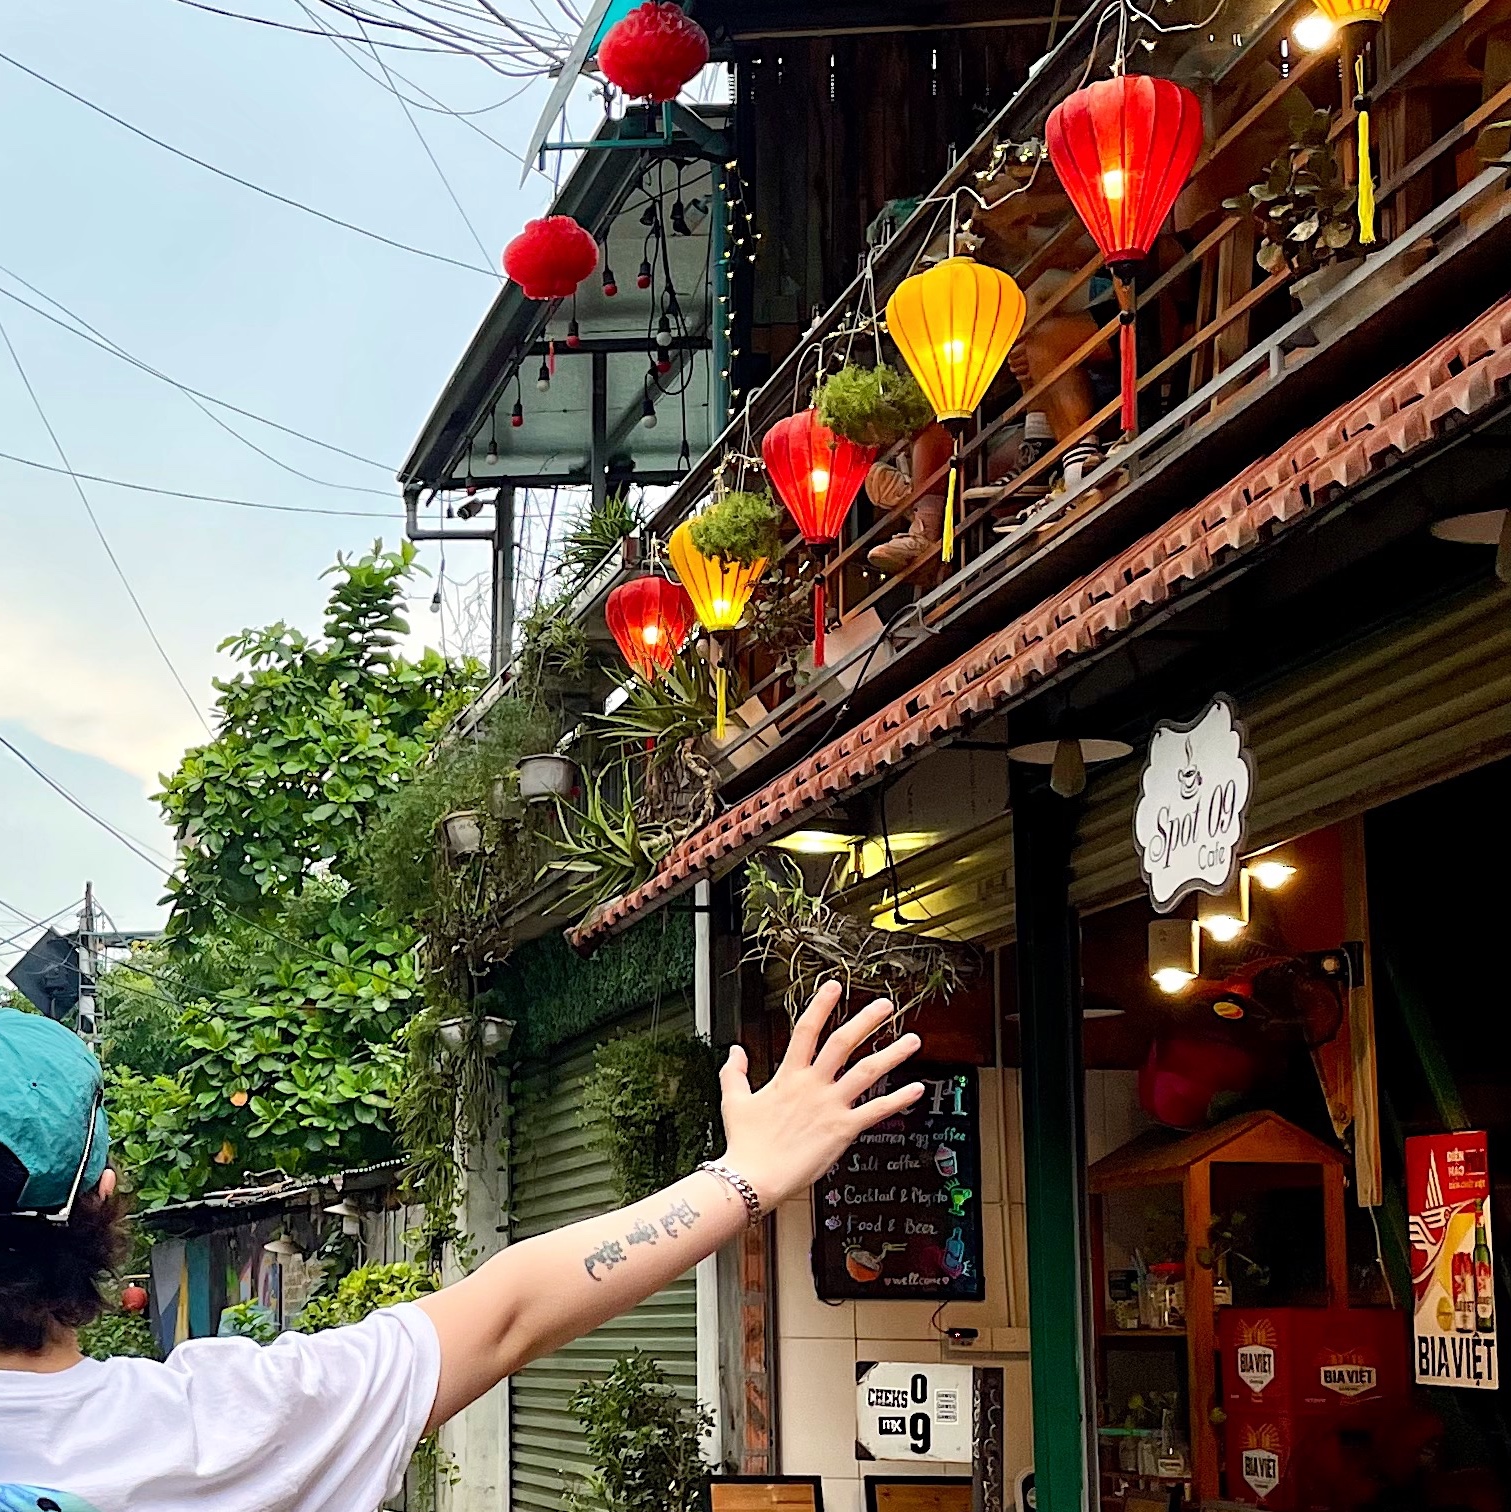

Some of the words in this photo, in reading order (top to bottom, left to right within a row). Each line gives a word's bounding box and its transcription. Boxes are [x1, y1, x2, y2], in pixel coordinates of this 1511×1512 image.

[1149, 796, 1201, 869] Spot
[1208, 780, 1235, 838] 09
[1198, 842, 1225, 870] Cafe
[932, 1126, 966, 1142] coffee
[846, 1212, 883, 1235] Food
[905, 1217, 938, 1235] Beer
